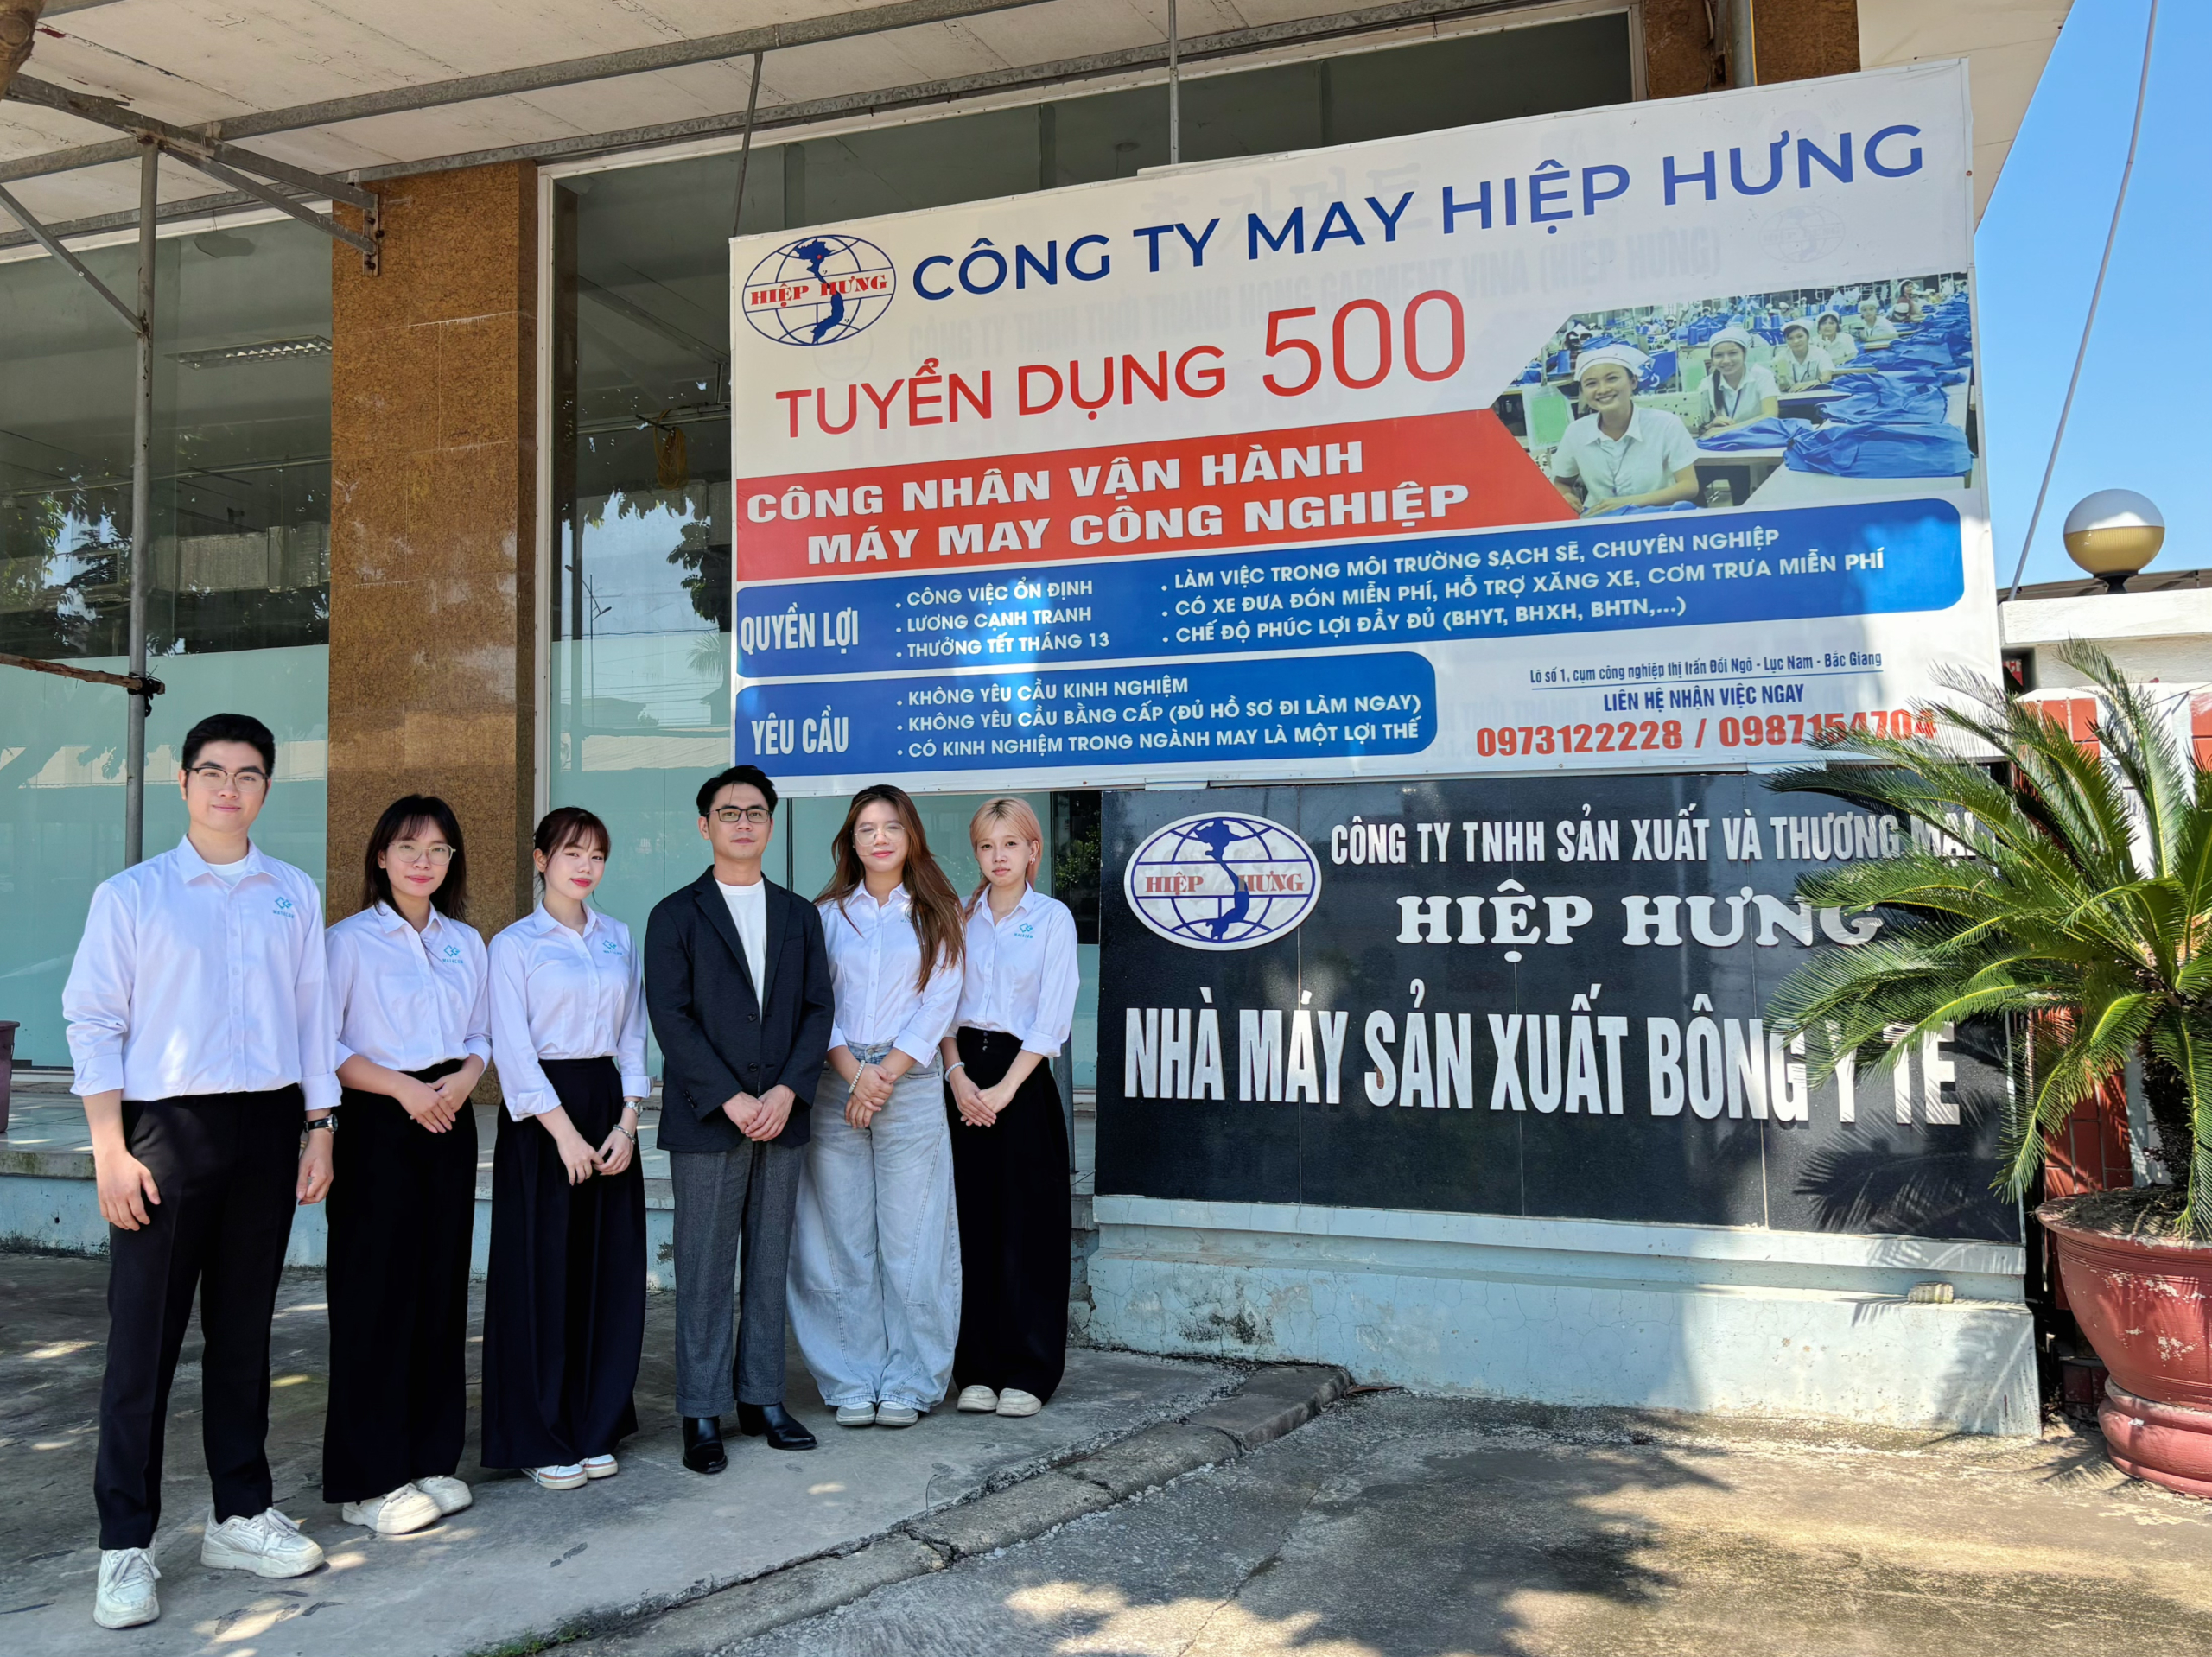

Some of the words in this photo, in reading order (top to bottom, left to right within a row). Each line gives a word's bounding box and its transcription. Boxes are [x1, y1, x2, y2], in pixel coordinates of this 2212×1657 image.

[912, 234, 1109, 300] CÔNG
[1133, 218, 1220, 272] TY
[1248, 191, 1414, 260] MAY
[1442, 159, 1630, 234] HIỆP
[1662, 124, 1923, 205] HƯNG
[751, 283, 810, 308] HIỆP
[820, 274, 887, 297] HƯNG
[775, 357, 991, 437] TUYỂN
[1018, 345, 1225, 420] DỤNG
[1262, 289, 1465, 397] 500
[747, 485, 882, 523] CÔNG
[903, 468, 1049, 511] NHÂN
[1068, 456, 1179, 500] VẬN
[1202, 441, 1362, 486] HÀNH
[808, 525, 919, 564] MÁY
[938, 517, 1050, 555] MAY
[1070, 505, 1222, 545] CÔNG
[1244, 480, 1468, 532] NGHIỆP
[1174, 568, 1214, 589] LÀM
[1219, 564, 1265, 589] VIỆC
[1269, 562, 1341, 582] TRONG
[1346, 555, 1387, 577] MÔI
[1393, 549, 1482, 574] TRƯỜNG
[1487, 546, 1548, 570] SẠCH
[1554, 540, 1586, 563] SẼ,
[1592, 532, 1685, 559] CHUYÊN
[1692, 524, 1780, 551] NGHIỆP
[1174, 594, 1206, 616] CÓ
[1211, 596, 1236, 614] XE
[1241, 594, 1284, 612] ĐƯA
[1288, 587, 1335, 609] ĐÓN
[1341, 580, 1391, 606] MIỄN
[1397, 578, 1438, 603] PHÍ,
[1445, 574, 1478, 599] HỖ
[1483, 575, 1526, 599] TRỢ
[1532, 570, 1600, 593] XĂNG
[1605, 568, 1641, 588] XE,
[1647, 562, 1706, 584] CƠM
[1711, 557, 1772, 580] TRƯA
[1779, 548, 1837, 575] MIỄN
[1844, 546, 1885, 571] PHÍ
[906, 586, 963, 606] CÔNG
[967, 581, 1009, 606] VIỆC
[1013, 576, 1042, 600] ỔN
[1046, 579, 1093, 600] ĐỊNH
[741, 602, 815, 655] QUYỀN
[823, 607, 858, 654] LỢI
[906, 613, 969, 632] LƯƠNG
[973, 610, 1027, 632] CẠNH
[1031, 606, 1092, 625] TRANH
[1175, 618, 1218, 643] CHẾ
[1219, 619, 1251, 644] ĐỘ
[1256, 616, 1313, 638] PHÚC
[1318, 614, 1351, 638] LỢI
[1356, 607, 1401, 632] ĐẦY
[1406, 606, 1435, 629] ĐỦ
[1442, 606, 1509, 632] (BHYT,
[1515, 602, 1584, 623] BHXH,
[1590, 595, 1687, 618] BHTN,...)
[906, 635, 982, 657] THƯỞNG
[986, 631, 1014, 654] TẾT
[1017, 631, 1083, 652] THÁNG
[1088, 632, 1110, 648] 13
[1529, 669, 1542, 683] Lô
[1544, 665, 1557, 683] số
[1559, 668, 1571, 683] 1,
[1572, 668, 1596, 682] cụm
[1598, 666, 1625, 681] công
[1627, 663, 1665, 680] nghiệp
[1667, 660, 1682, 676] thị
[1684, 661, 1707, 676] trấn
[1708, 657, 1728, 674] Đồi
[1730, 657, 1753, 675] Ngô
[1763, 656, 1784, 671] Lục
[1786, 655, 1814, 670] Nam
[1824, 652, 1847, 668] Bắc
[1848, 650, 1882, 667] Giang
[908, 685, 975, 706] KHÔNG
[979, 682, 1012, 702] YÊU
[1016, 677, 1057, 702] CẦU
[1062, 681, 1108, 699] KINH
[1113, 673, 1188, 698] NGHIỆM
[908, 711, 975, 732] KHÔNG
[979, 708, 1012, 728] YÊU
[1017, 703, 1058, 727] CẦU
[1063, 702, 1117, 725] BẰNG
[1122, 699, 1164, 723] CẤP
[1168, 698, 1204, 725] (ĐỦ
[1210, 695, 1240, 719] HỒ
[1245, 698, 1274, 717] SƠ
[1278, 699, 1300, 715] ĐI
[1306, 694, 1348, 714] LÀM
[1353, 694, 1421, 714] NGAY)
[1603, 688, 1639, 712] LIÊN
[1643, 686, 1665, 713] HỆ
[1669, 684, 1716, 708] NHẬN
[1719, 682, 1757, 706] VIỆC
[1761, 683, 1804, 704] NGAY
[751, 712, 794, 754] YÊU
[802, 705, 849, 753] CẦU
[907, 737, 937, 758] CÓ
[942, 740, 985, 757] KINH
[990, 733, 1063, 757] NGHIỆM
[1067, 733, 1134, 752] TRONG
[1139, 727, 1210, 749] NGÀNH
[1216, 728, 1258, 746] MAY
[1263, 723, 1288, 745] LÀ
[1294, 721, 1338, 746] MỘT
[1344, 721, 1376, 745] LỢI
[1381, 714, 1422, 740] THẾ
[1477, 720, 1682, 757] 0973122228
[1694, 718, 1707, 748] /
[1331, 816, 1406, 865] CÔNG
[1417, 822, 1450, 863] TY
[1463, 821, 1545, 863] TNHH
[1556, 803, 1619, 862] SẢN
[1631, 803, 1710, 861] XUẤT
[1722, 809, 1763, 860] VÀ
[1770, 811, 1900, 860] THƯƠNG
[1145, 871, 1204, 896] HIỆP
[1237, 870, 1305, 892] HƯNG
[1396, 879, 1594, 962] HIỆP
[1621, 886, 1884, 948] HƯNG
[1124, 987, 1226, 1100] NHÀ
[1239, 990, 1350, 1104] MÁY
[1364, 978, 1473, 1109] SẢN
[1487, 983, 1628, 1114] XUẤT
[1647, 994, 1808, 1121] BÔNG
